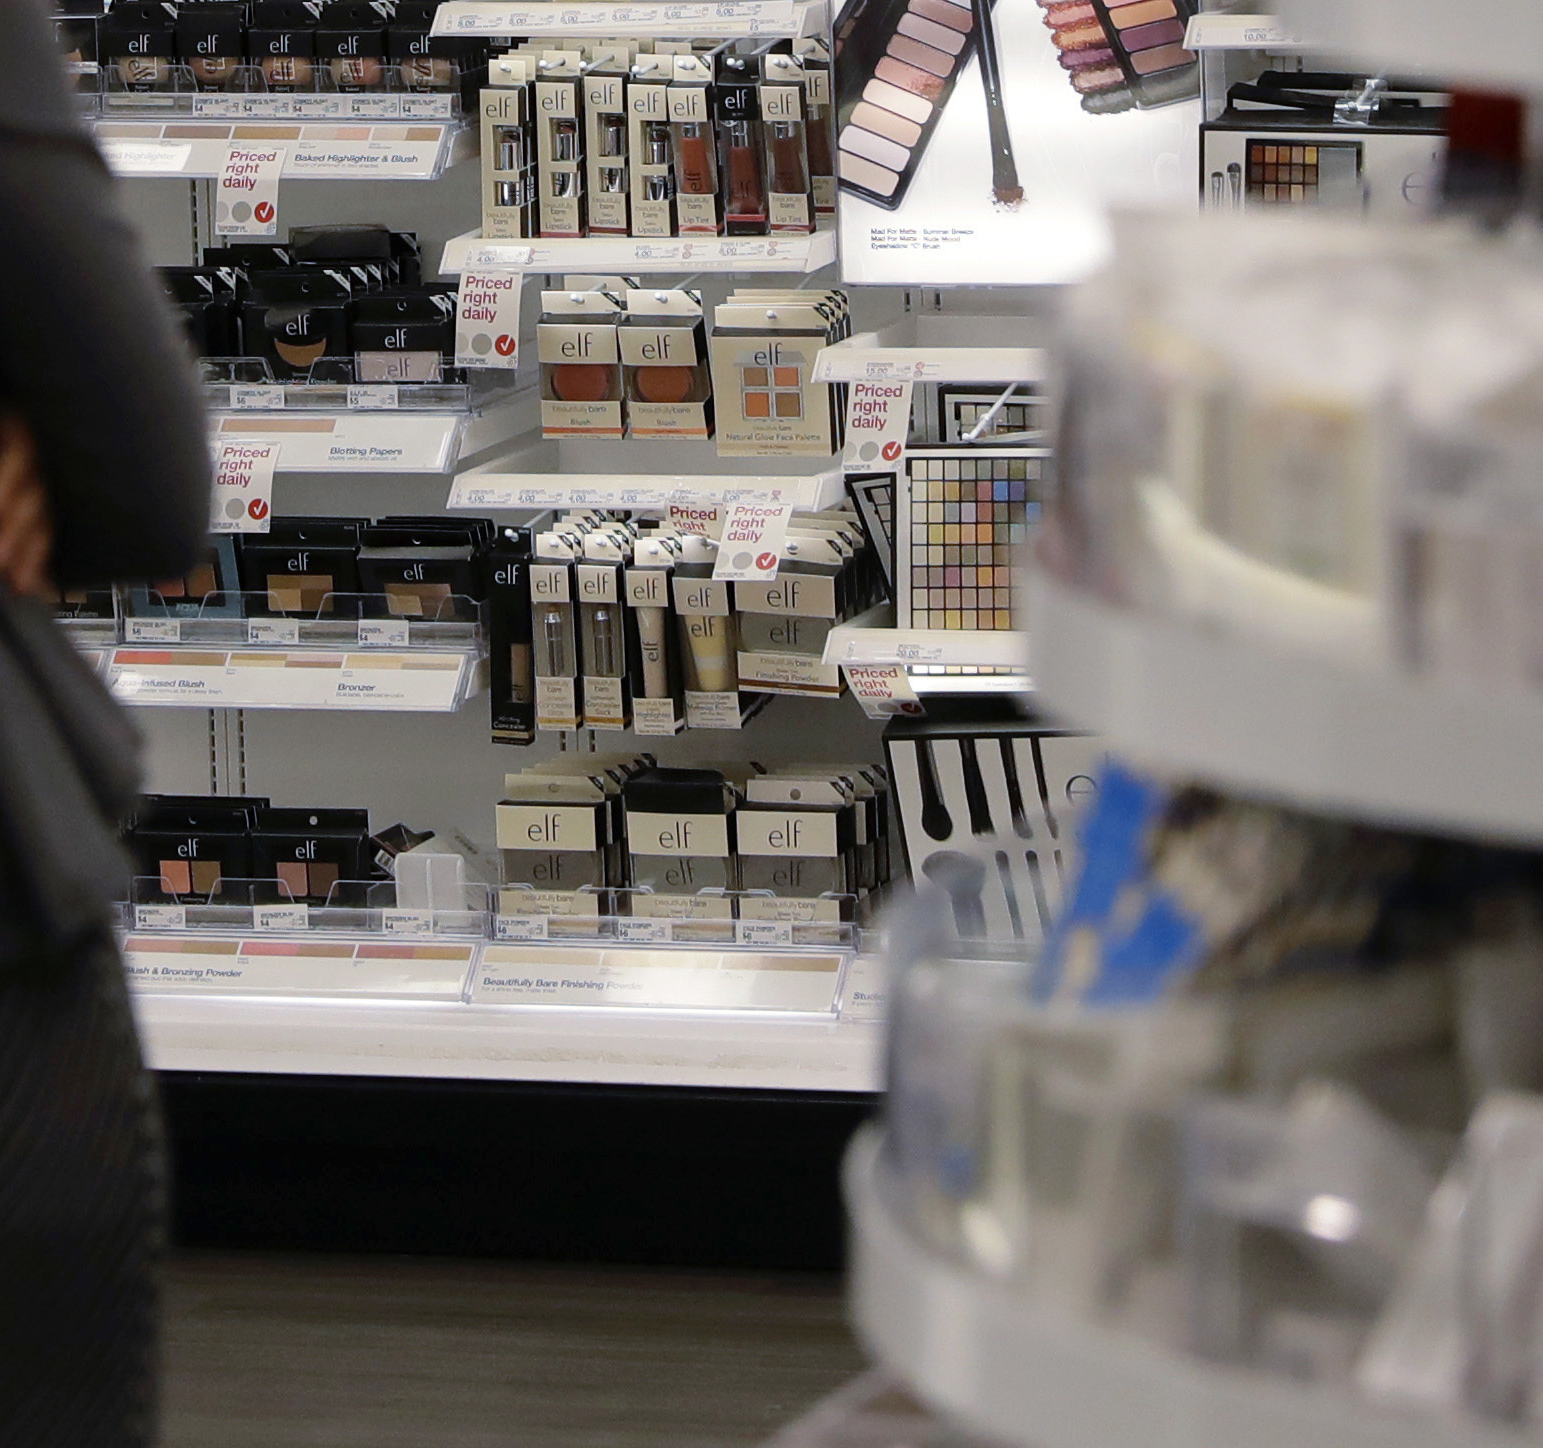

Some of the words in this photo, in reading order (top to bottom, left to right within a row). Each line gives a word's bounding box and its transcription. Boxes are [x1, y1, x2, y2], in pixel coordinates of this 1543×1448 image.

[229, 151, 277, 162] Priced
[294, 154, 325, 162] Baked
[328, 154, 379, 164] Highlighter
[391, 155, 418, 163] Blush
[225, 162, 260, 176] right
[222, 175, 256, 191] daily
[465, 276, 513, 290] Priced
[463, 292, 497, 307] right
[461, 306, 497, 323] daily
[854, 383, 903, 398] Priced
[853, 400, 888, 415] right
[851, 415, 887, 431] daily
[223, 446, 271, 458] Priced
[369, 447, 402, 456] Papers
[219, 459, 254, 472] right
[216, 472, 251, 488] daily
[337, 682, 376, 691] Bronzer
[161, 967, 204, 978] Bronzing
[206, 968, 242, 977] Powder
[483, 977, 533, 987] Beautifully
[535, 978, 558, 988] Bare
[560, 979, 604, 990] Finishing
